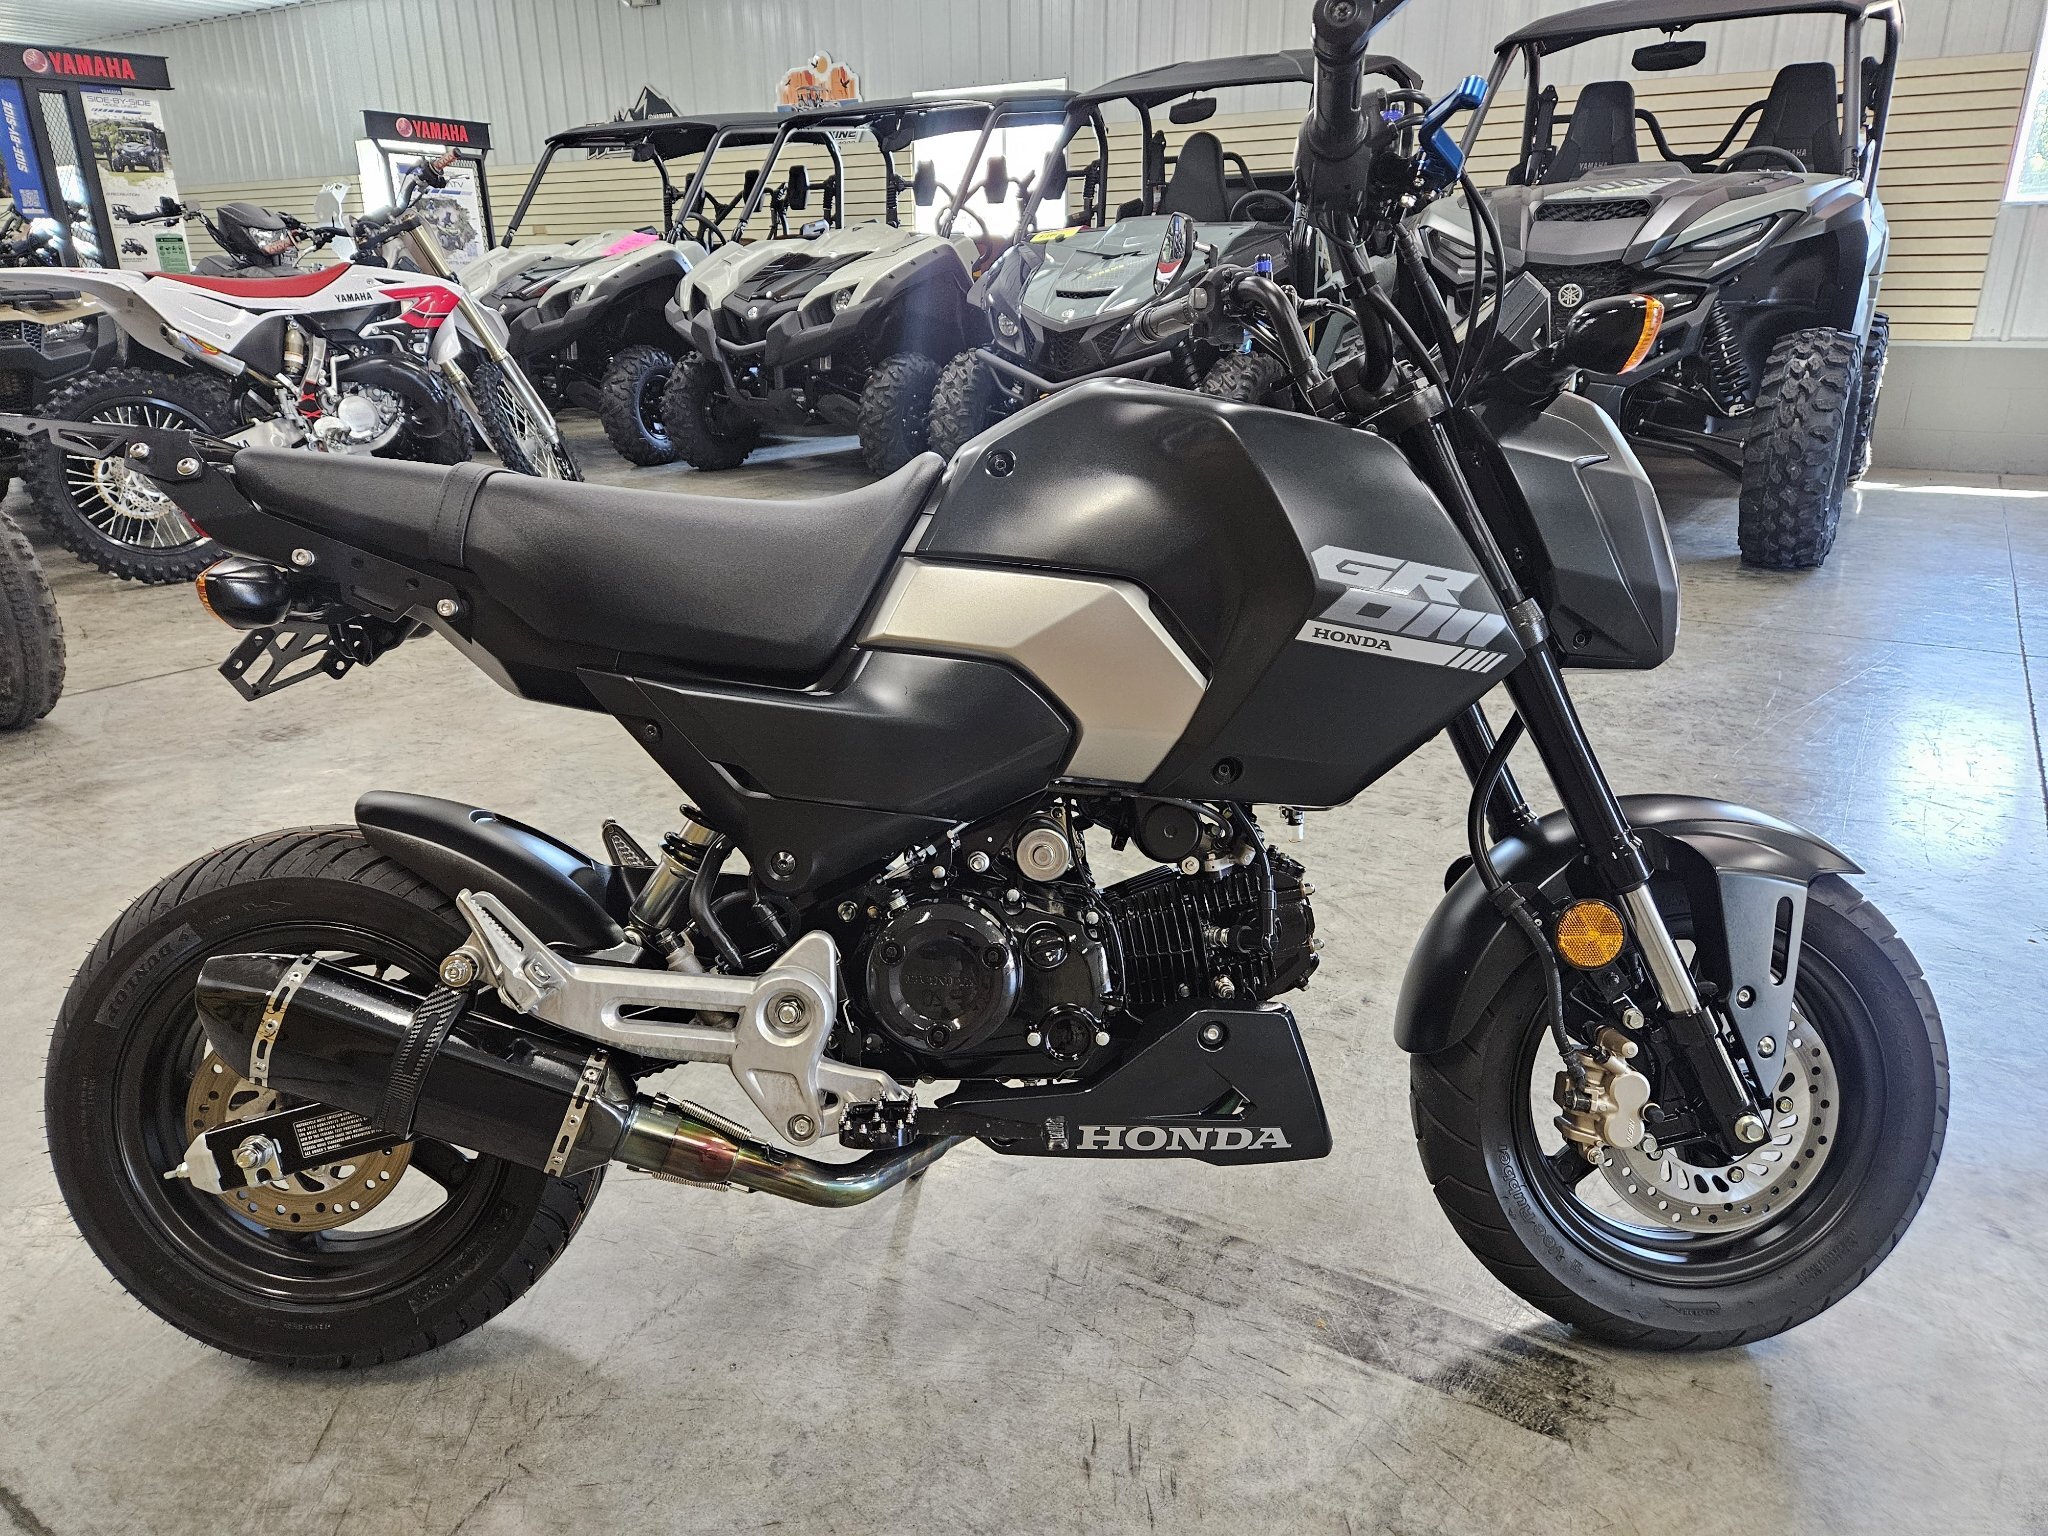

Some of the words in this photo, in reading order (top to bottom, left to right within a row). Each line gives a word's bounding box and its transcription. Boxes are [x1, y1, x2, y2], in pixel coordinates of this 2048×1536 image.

[47, 52, 136, 80] YAMAHA
[87, 95, 151, 107] SIDE-BY-SIDE
[1, 98, 29, 174] SIDE-BY-SIDE
[412, 120, 469, 143] YAMAHA
[335, 291, 374, 304] YAMAHA
[1311, 627, 1393, 652] HONDA
[108, 940, 173, 1023] DUNLOP
[1076, 1125, 1293, 1151] HONDA
